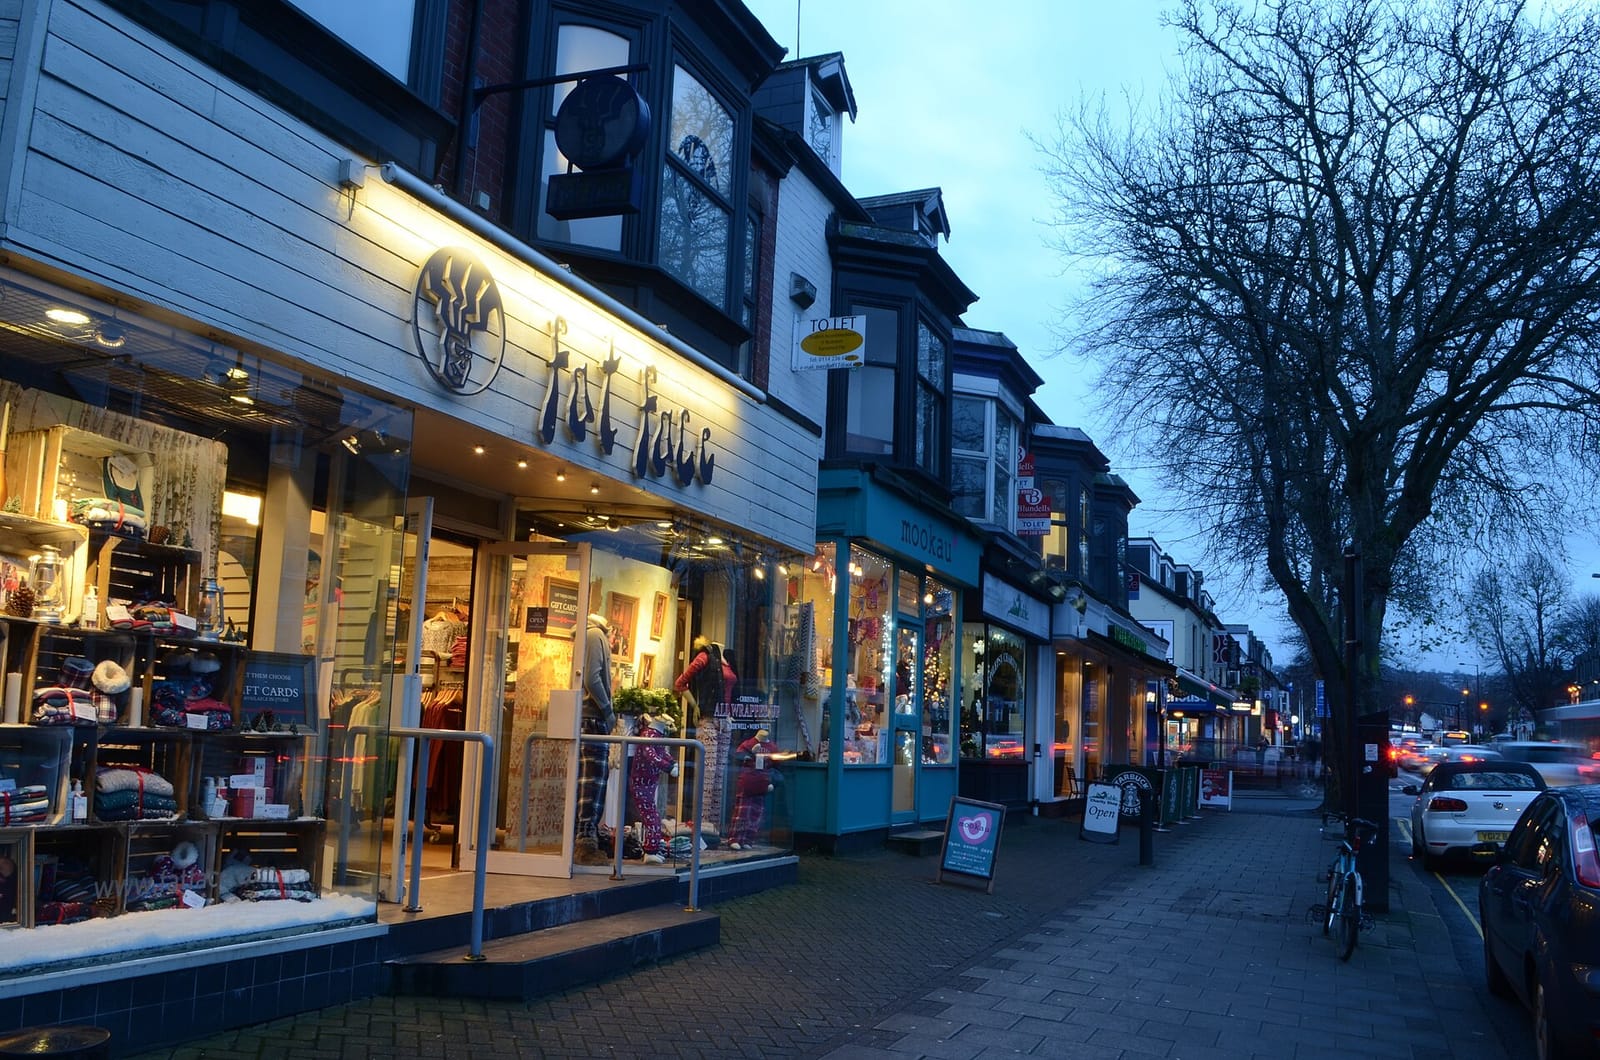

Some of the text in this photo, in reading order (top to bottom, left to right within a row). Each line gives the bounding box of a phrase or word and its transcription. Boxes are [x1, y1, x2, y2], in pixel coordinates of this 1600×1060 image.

[811, 317, 855, 331] TO LET
[538, 315, 716, 487] fat face
[901, 520, 951, 562] mookau
[261, 687, 298, 698] CARDS
[1089, 806, 1115, 819] Open
[959, 822, 989, 833] mookau
